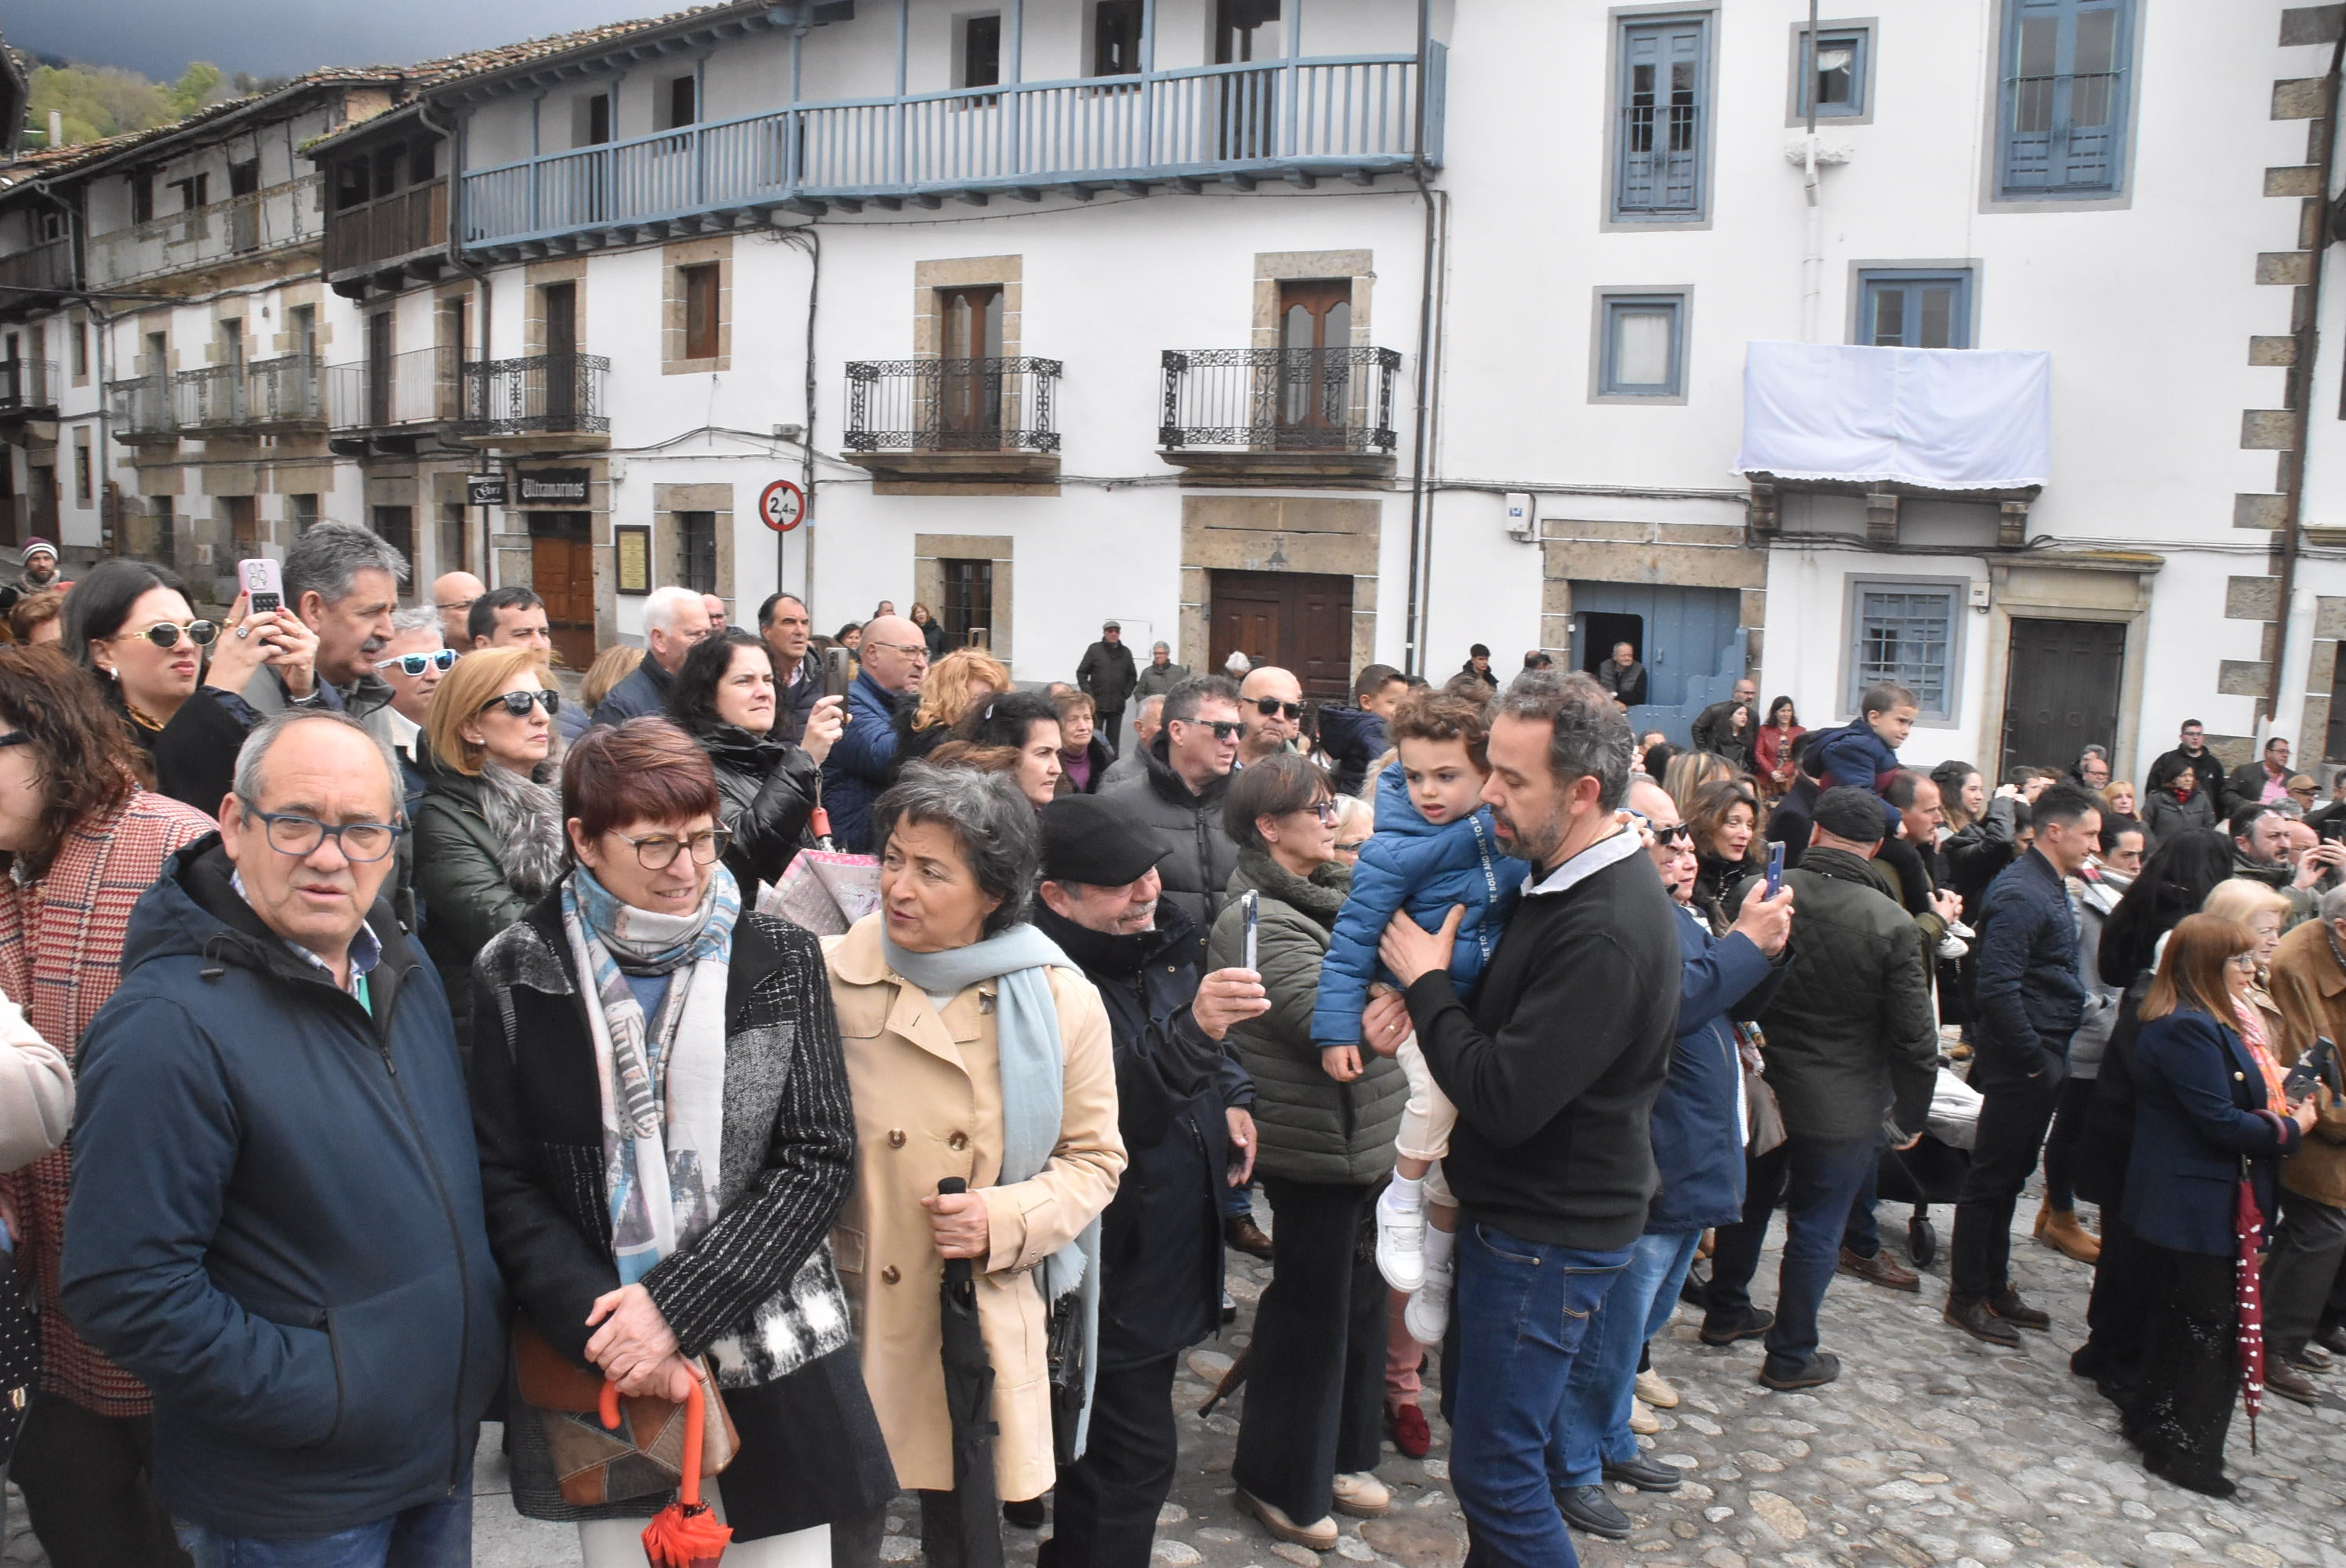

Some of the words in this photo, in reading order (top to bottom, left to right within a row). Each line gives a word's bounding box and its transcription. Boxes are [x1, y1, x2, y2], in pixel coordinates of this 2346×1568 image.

[1474, 825, 1484, 837] TO
[1481, 855, 1491, 870] AND
[1485, 871, 1497, 891] BOLD
[1490, 894, 1498, 903] BE
[1479, 935, 1487, 946] TO
